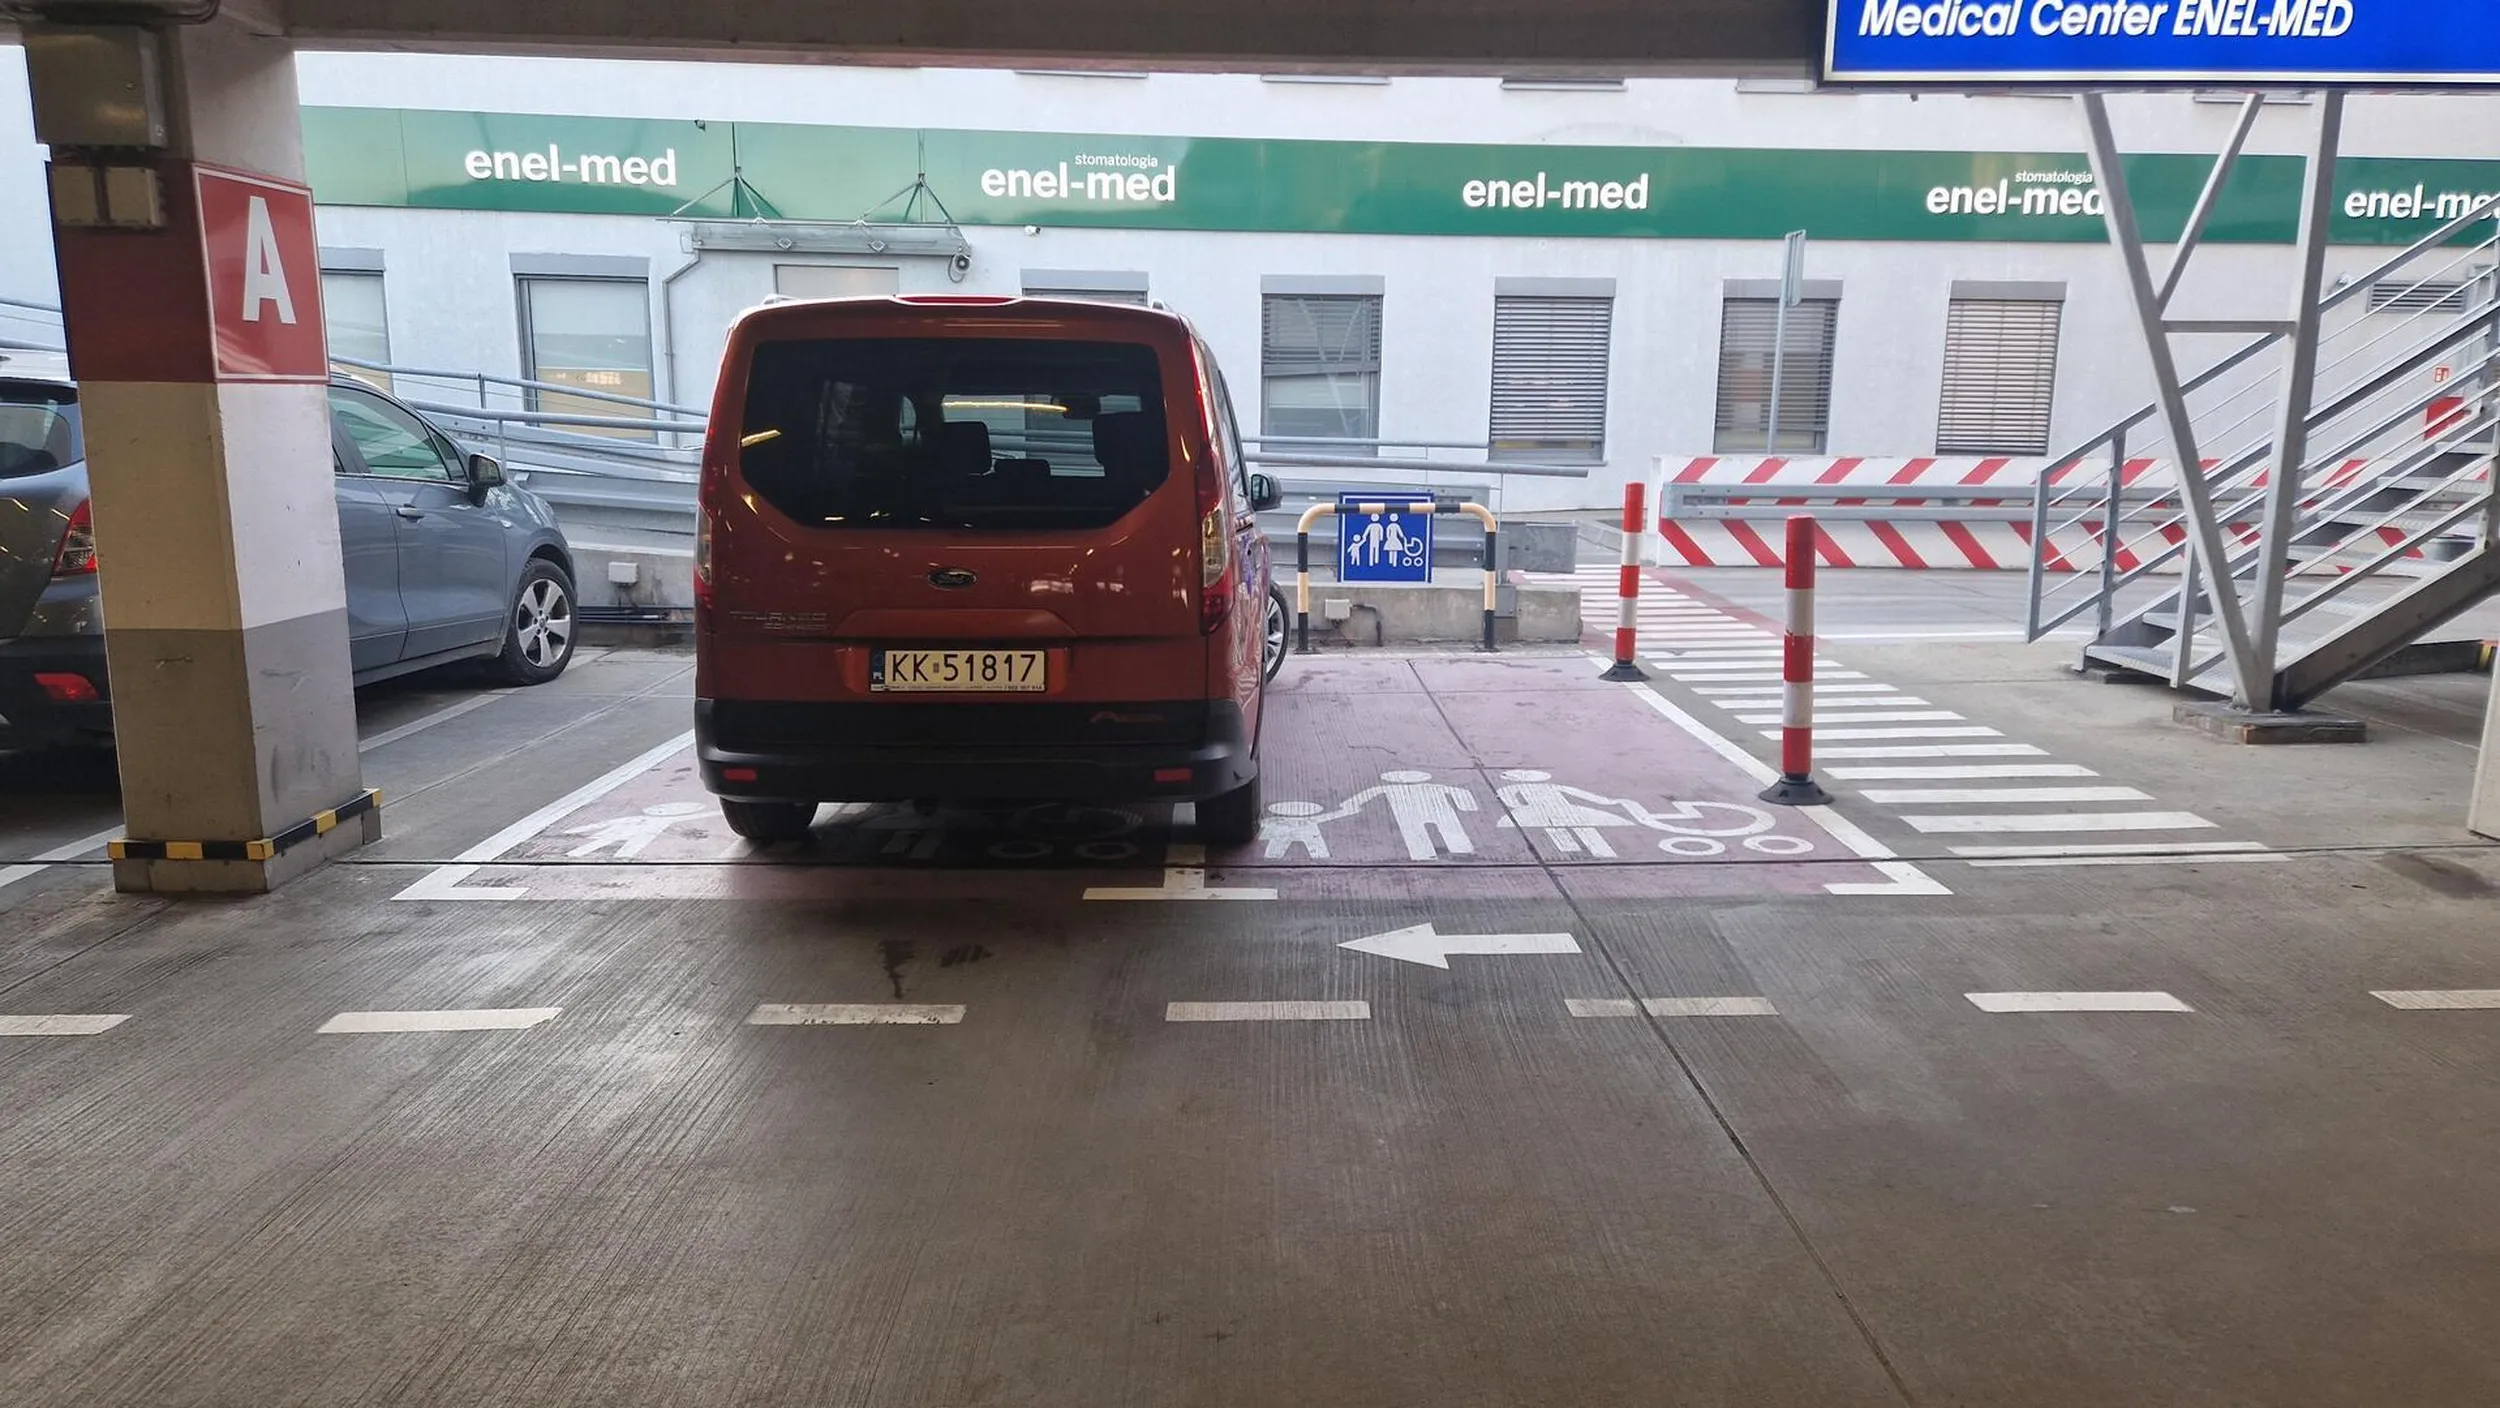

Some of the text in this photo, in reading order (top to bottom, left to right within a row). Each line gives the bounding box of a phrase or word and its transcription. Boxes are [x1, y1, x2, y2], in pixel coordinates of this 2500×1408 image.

[1858, 0, 2355, 37] Medical Center ENEL-MED
[465, 143, 677, 186] enel-med
[1075, 153, 1158, 168] stomatologia
[2015, 169, 2094, 184] stomatologia
[981, 161, 1175, 201] enel-med
[1462, 171, 1649, 209] enel-med
[2344, 182, 2500, 219] enel-me
[242, 195, 297, 325] A
[943, 653, 1036, 682] 51817
